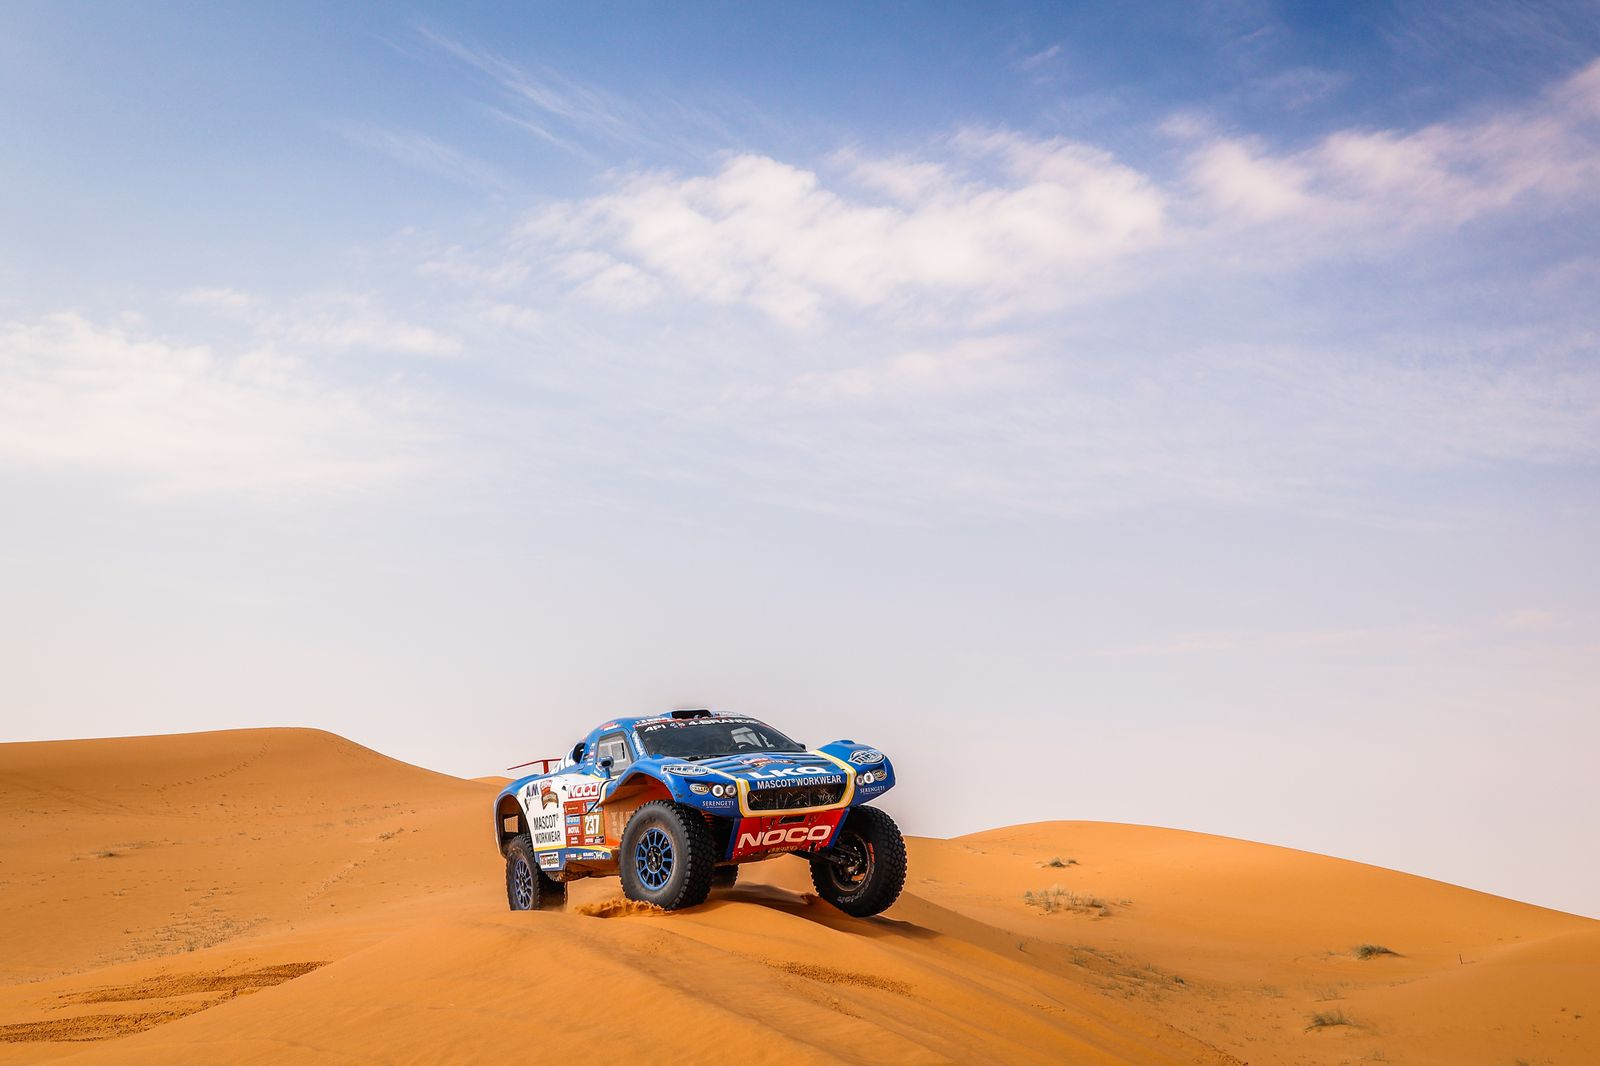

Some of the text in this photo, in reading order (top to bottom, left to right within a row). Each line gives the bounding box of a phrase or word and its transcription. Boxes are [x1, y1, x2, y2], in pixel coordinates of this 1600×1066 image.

[748, 766, 833, 779] LKQ
[795, 775, 842, 787] WORKWEAR
[568, 783, 599, 798] NOCO
[860, 786, 885, 794] SERENGETI
[584, 814, 600, 835] 237
[534, 830, 562, 844] WORKWEAR
[737, 826, 831, 848] NOCO
